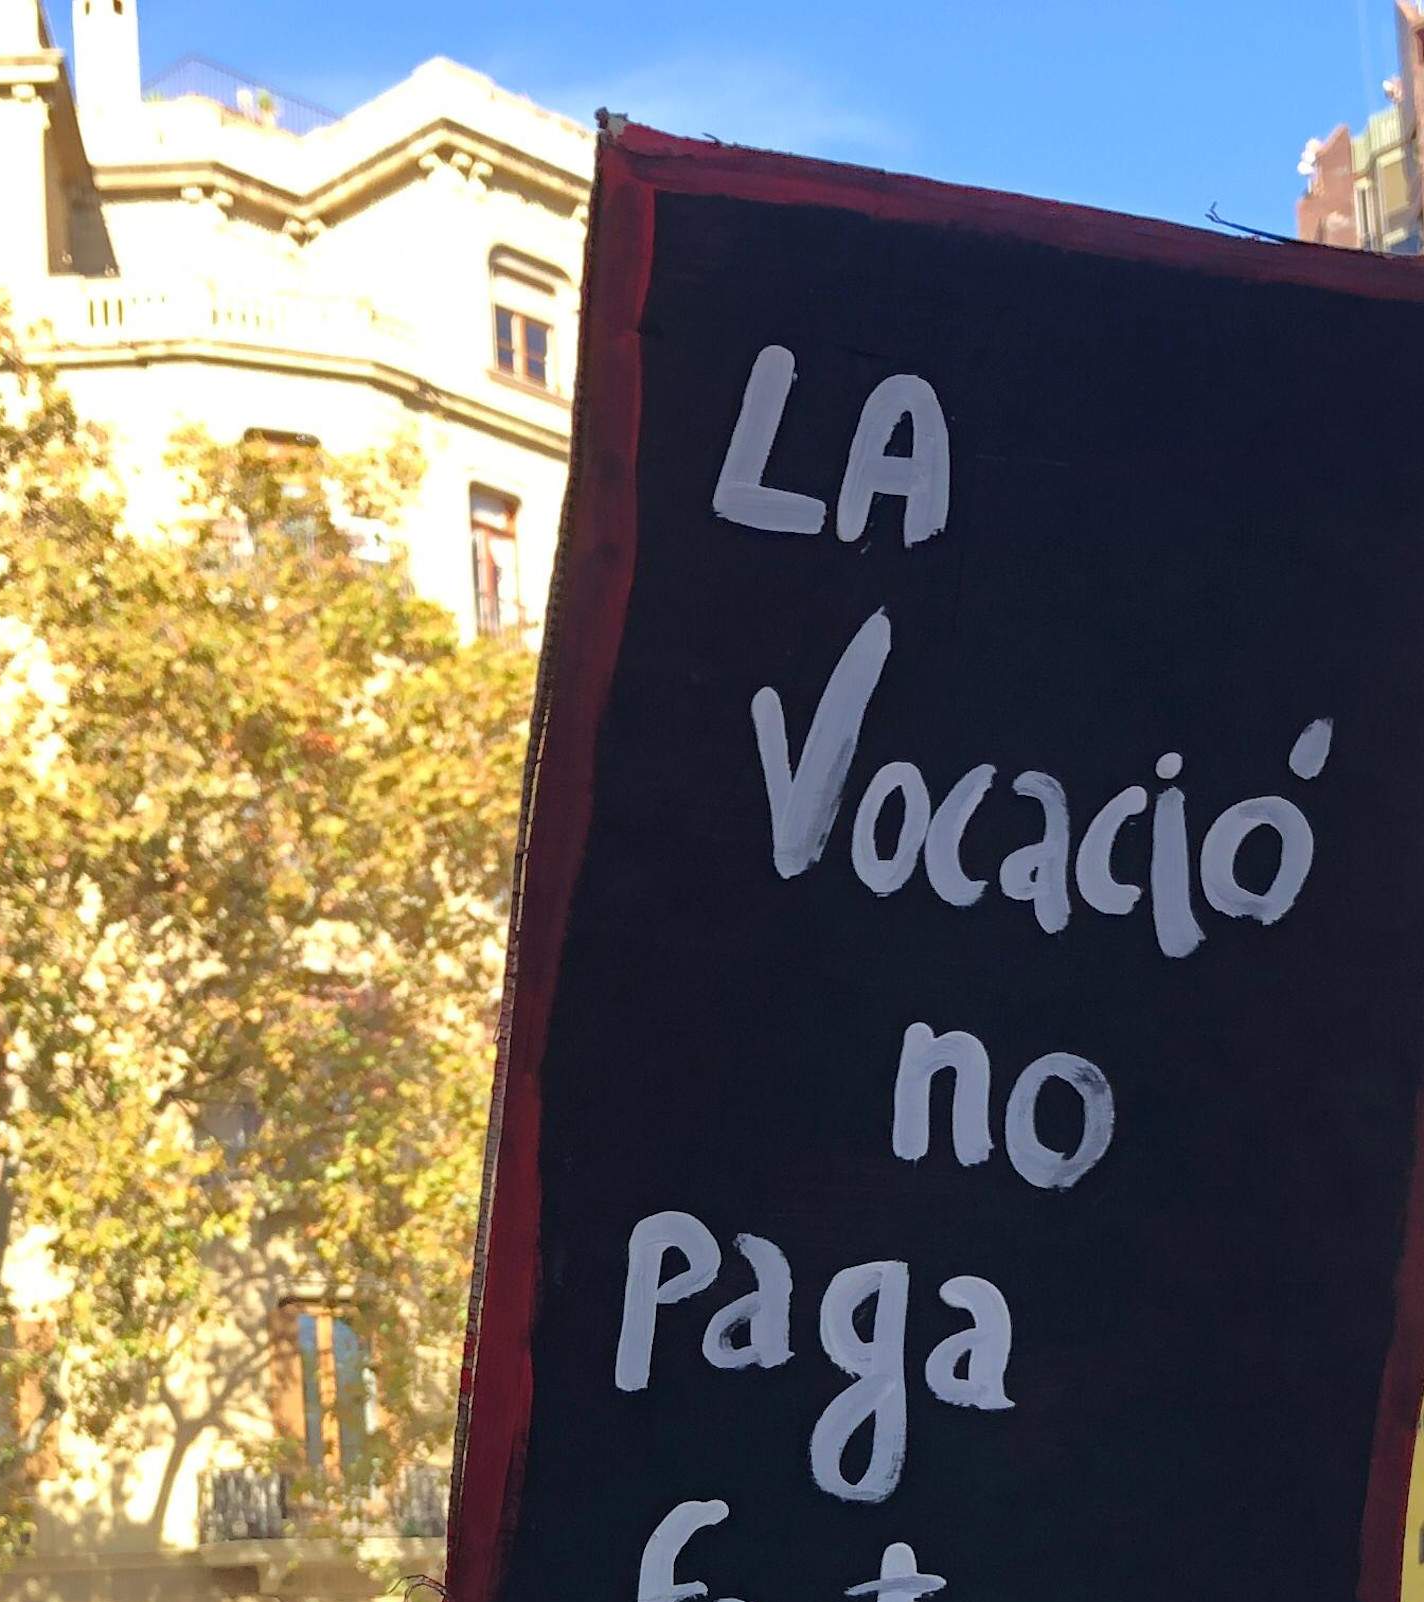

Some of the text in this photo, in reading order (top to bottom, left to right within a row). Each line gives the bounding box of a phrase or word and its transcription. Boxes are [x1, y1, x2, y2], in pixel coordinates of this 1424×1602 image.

[713, 344, 950, 549] LA
[750, 606, 1335, 958] Vocació
[891, 1020, 1116, 1189] no
